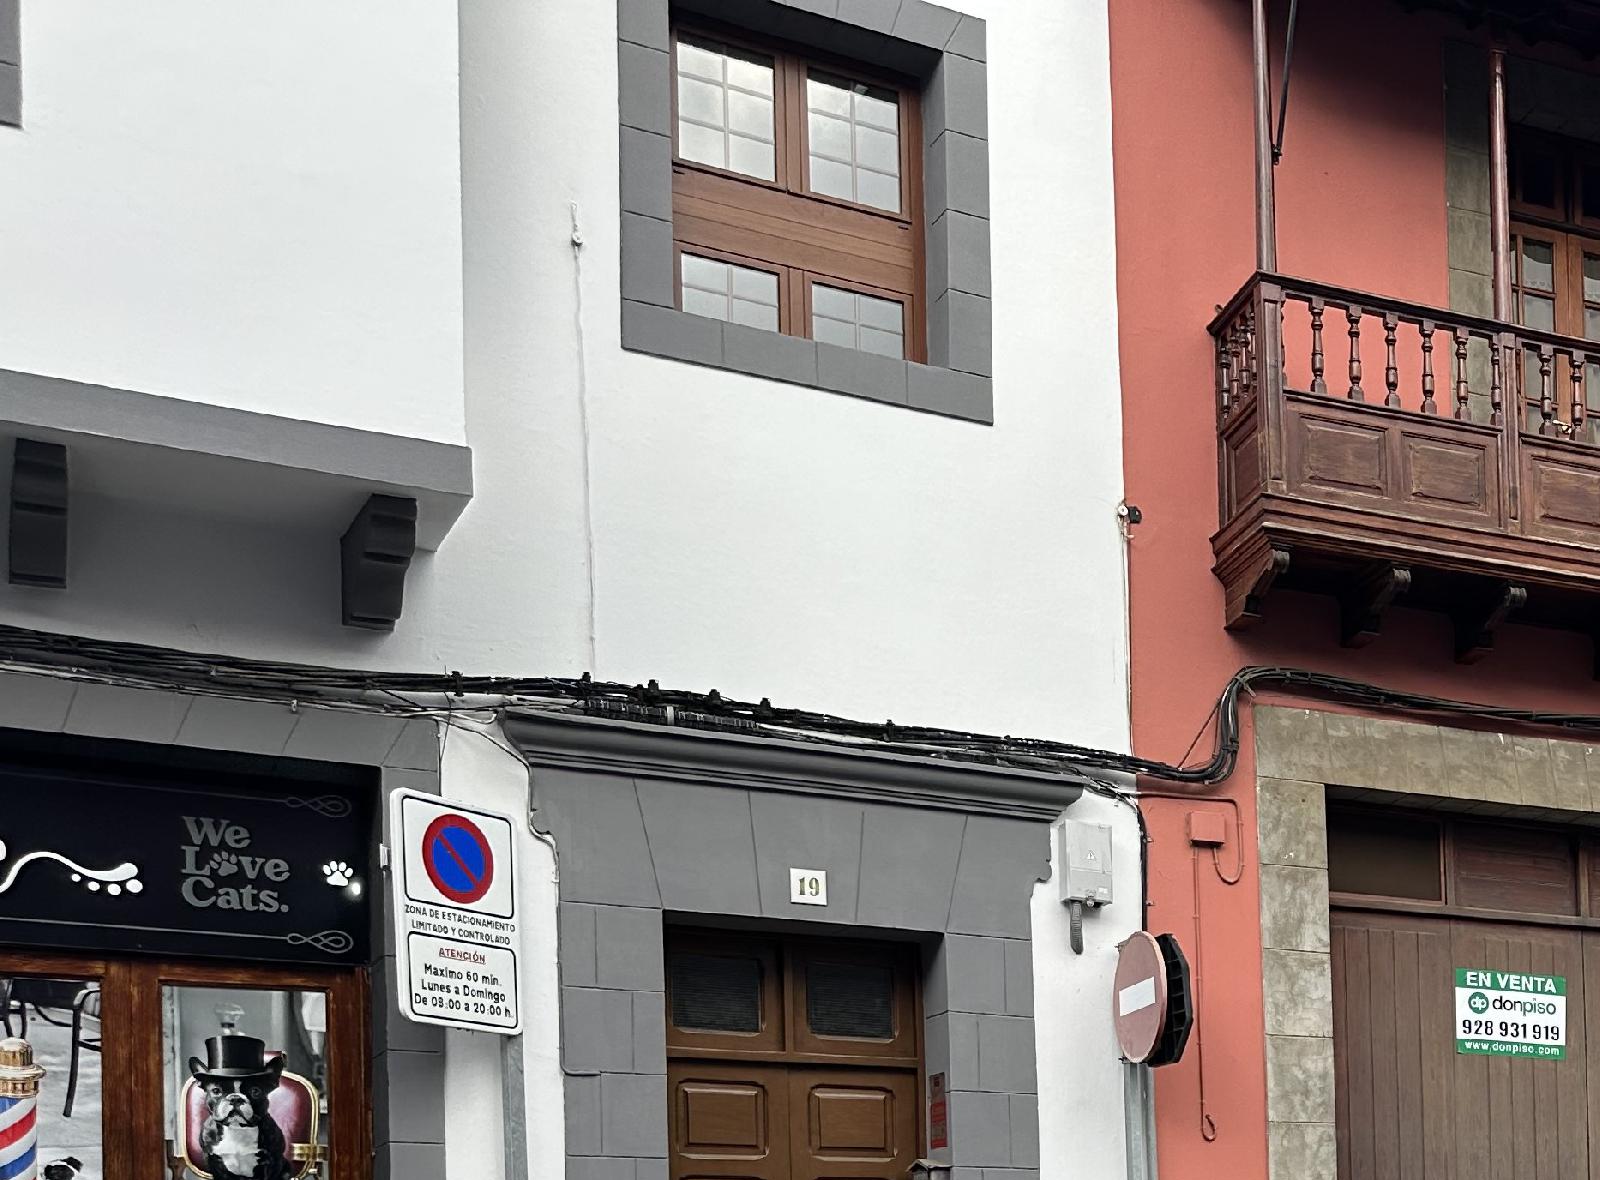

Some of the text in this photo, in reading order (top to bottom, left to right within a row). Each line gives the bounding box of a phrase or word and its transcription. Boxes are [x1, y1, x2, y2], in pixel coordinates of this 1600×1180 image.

[181, 816, 251, 848] We
[181, 876, 289, 913] Cats.
[799, 877, 820, 896] 19
[405, 904, 515, 932] ZONA DE ESTACIONAMIENTO
[412, 920, 510, 945] LIMITADO Y CONTROLADO
[439, 947, 486, 964] ATENCIÓN
[466, 971, 479, 982] 60
[1466, 971, 1557, 993] EN VENTA
[421, 979, 506, 1003] Lunes a Domingo
[414, 993, 428, 1006] De
[464, 1003, 470, 1012] a
[473, 1003, 502, 1016] 20:00
[1492, 995, 1556, 1016] donpiso
[1462, 1019, 1560, 1040] 928 931 919
[1465, 1041, 1560, 1055] www.donpiso.com
